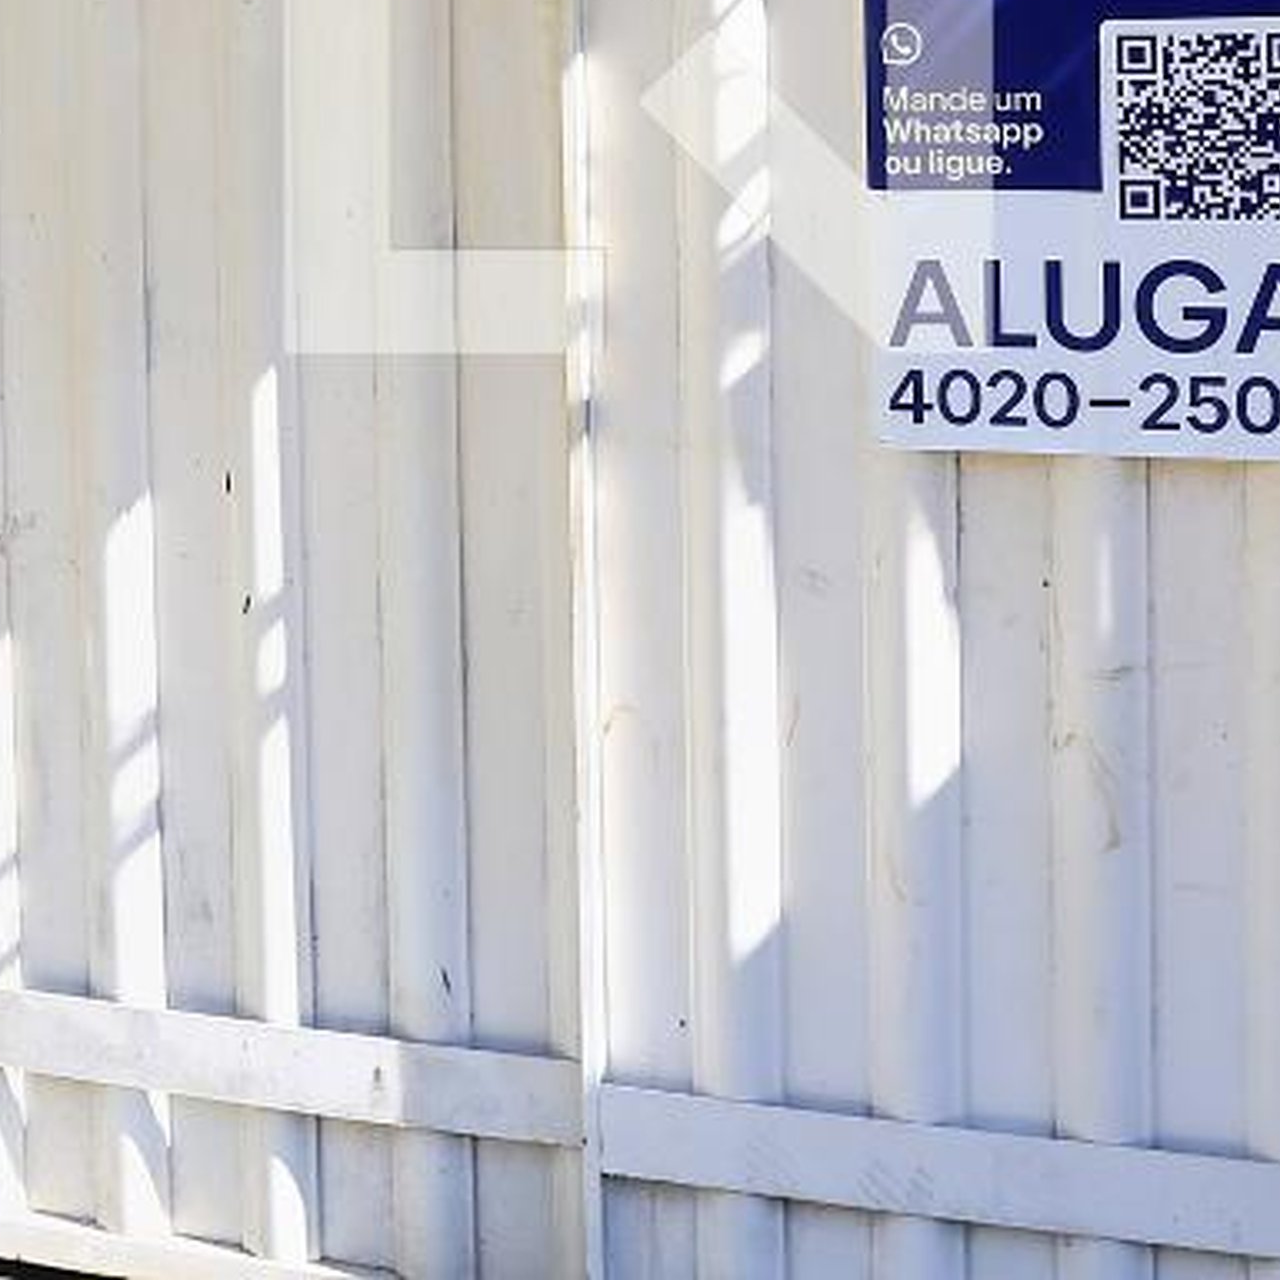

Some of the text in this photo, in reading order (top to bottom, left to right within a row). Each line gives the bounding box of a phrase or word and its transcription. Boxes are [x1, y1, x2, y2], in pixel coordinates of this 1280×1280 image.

[883, 86, 1042, 111] Mande um
[883, 119, 1043, 149] Whatsapp
[885, 150, 1012, 180] ou ligue.
